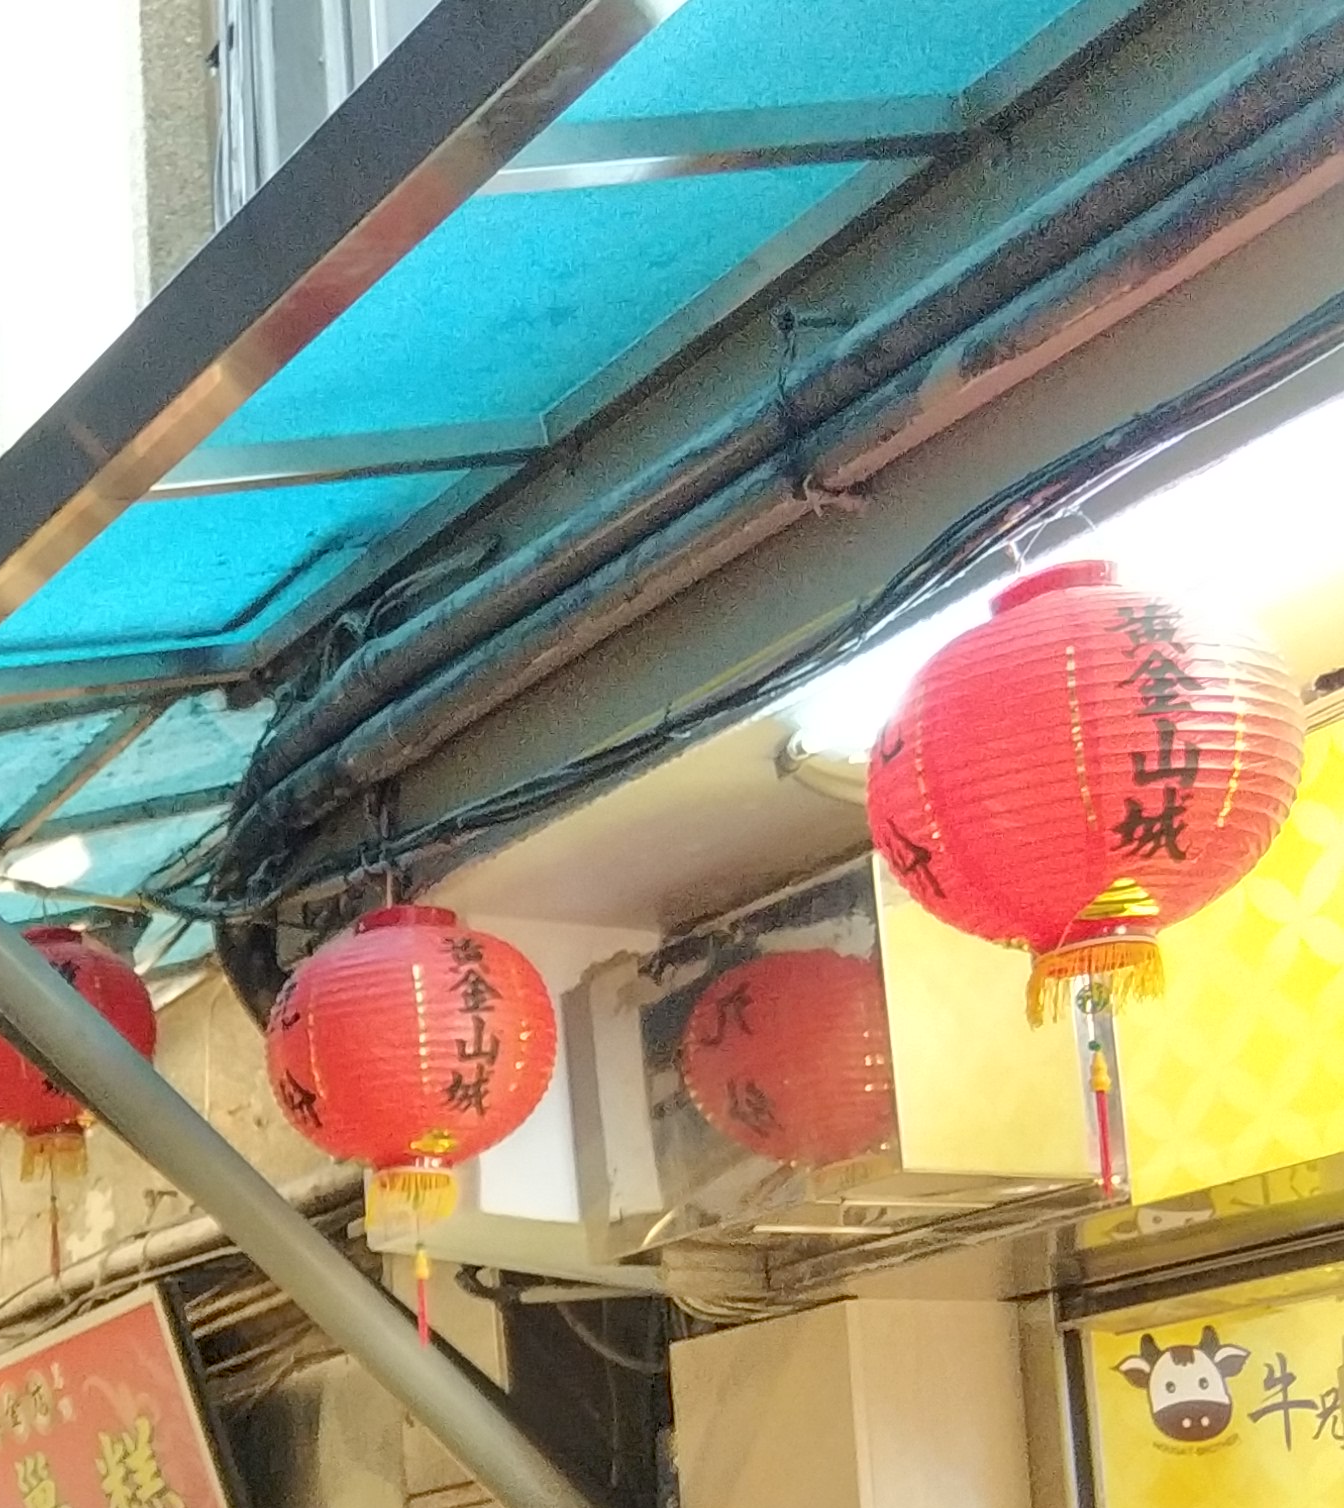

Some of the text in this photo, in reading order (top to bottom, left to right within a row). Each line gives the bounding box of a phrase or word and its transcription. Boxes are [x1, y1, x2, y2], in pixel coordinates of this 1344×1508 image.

[1103, 603, 1205, 860] 黃金山城
[442, 936, 502, 1117] 黃金山城
